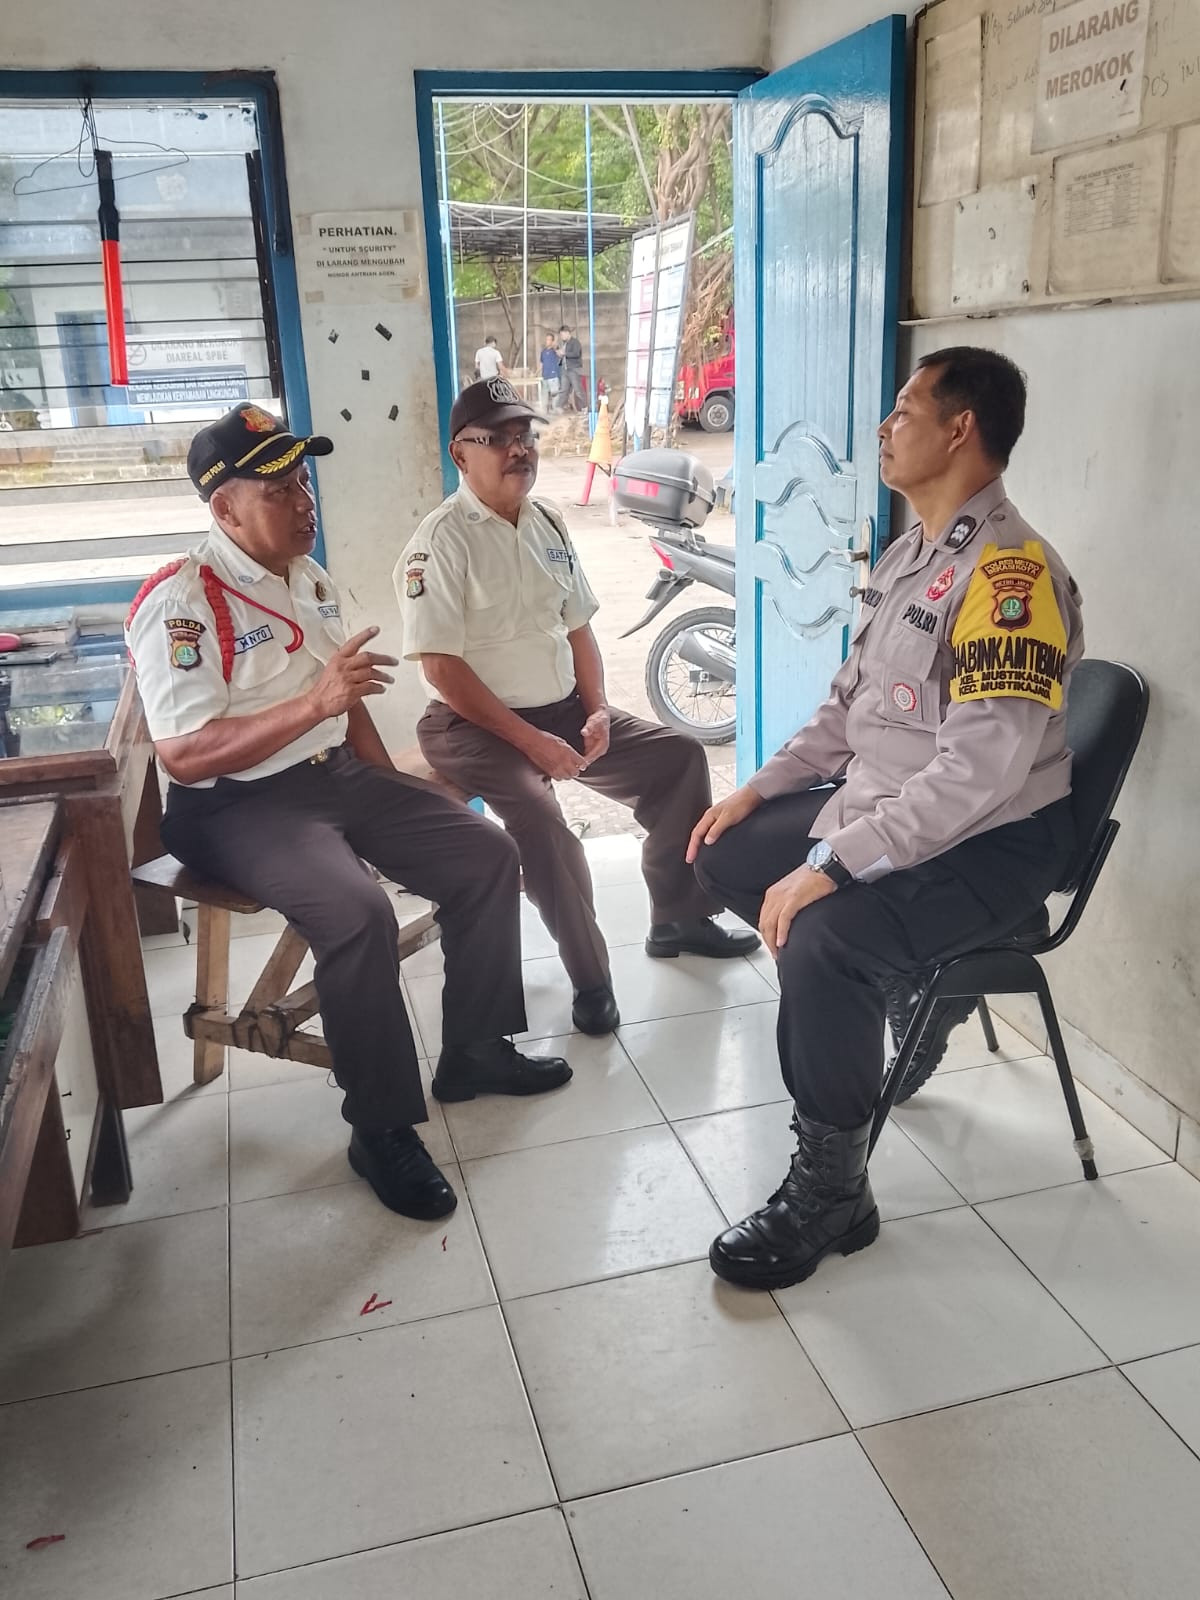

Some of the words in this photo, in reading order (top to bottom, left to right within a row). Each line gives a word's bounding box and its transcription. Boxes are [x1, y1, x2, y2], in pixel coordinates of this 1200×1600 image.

[1049, 0, 1139, 53] DILARANG
[1046, 50, 1134, 100] MEROKOK
[319, 226, 397, 237] PERHATIAN.
[327, 259, 359, 267] LARANG
[360, 258, 405, 266] MENGUBAH
[168, 619, 201, 631] POLDA
[902, 603, 938, 635] POLRI
[959, 684, 978, 697] KEC.
